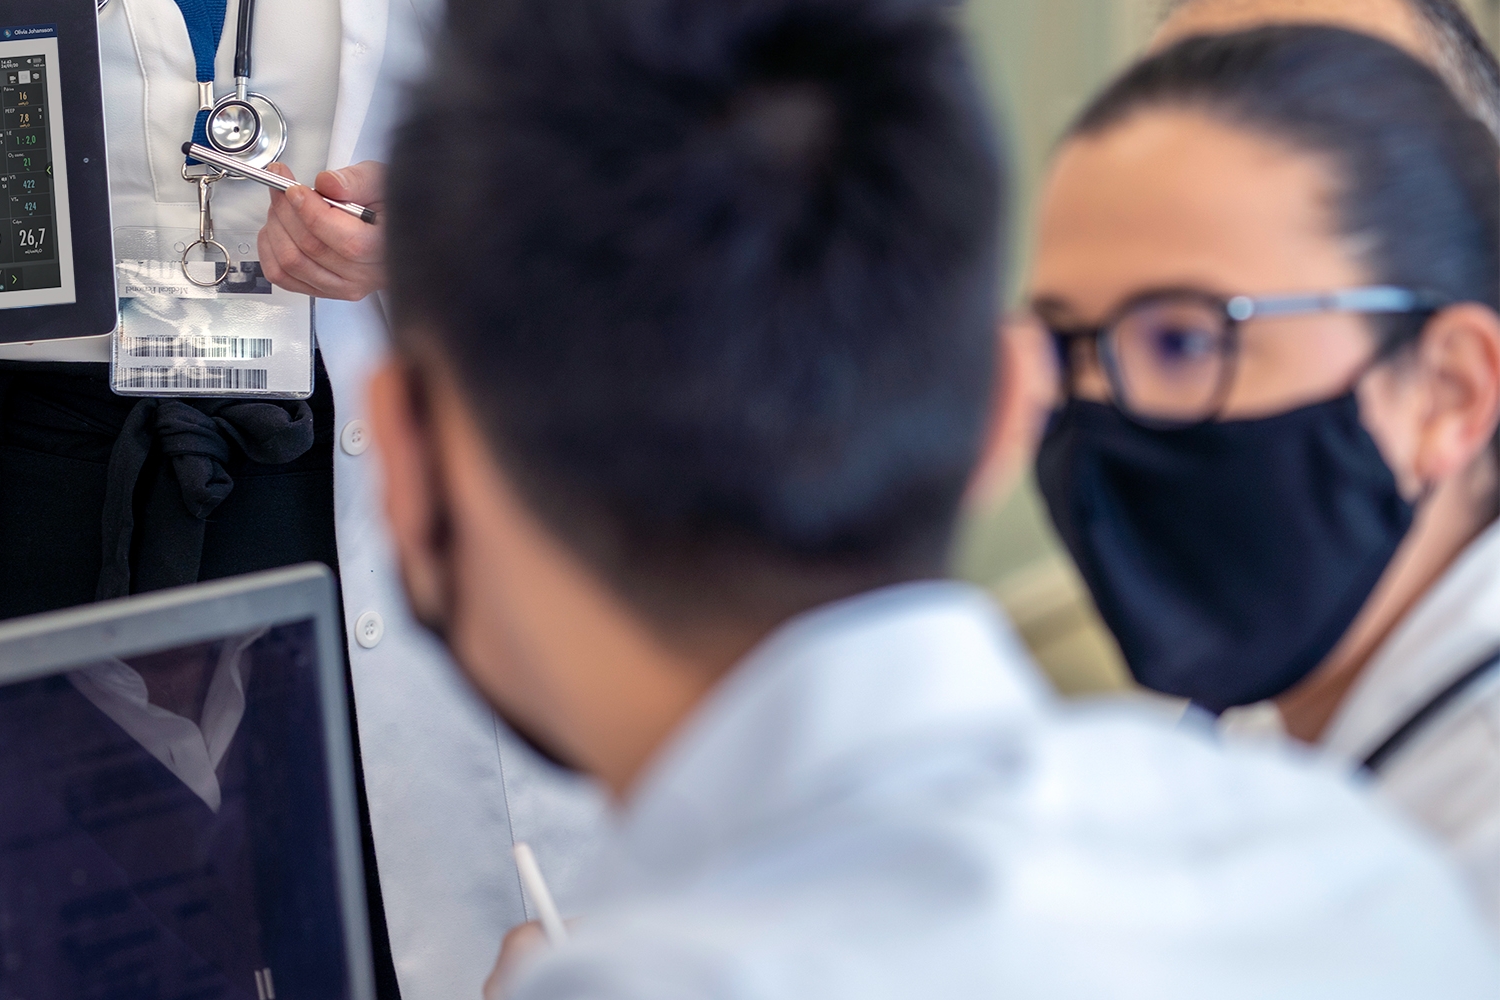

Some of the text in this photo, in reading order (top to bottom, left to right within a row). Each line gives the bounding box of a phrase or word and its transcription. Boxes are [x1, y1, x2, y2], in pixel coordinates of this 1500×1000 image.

[19, 91, 27, 100] 16
[20, 113, 29, 123] 7,8
[23, 158, 31, 166] 21
[23, 180, 35, 189] 422
[24, 202, 36, 211] 424
[19, 228, 46, 248] 26,7
[158, 286, 188, 294] Medical
